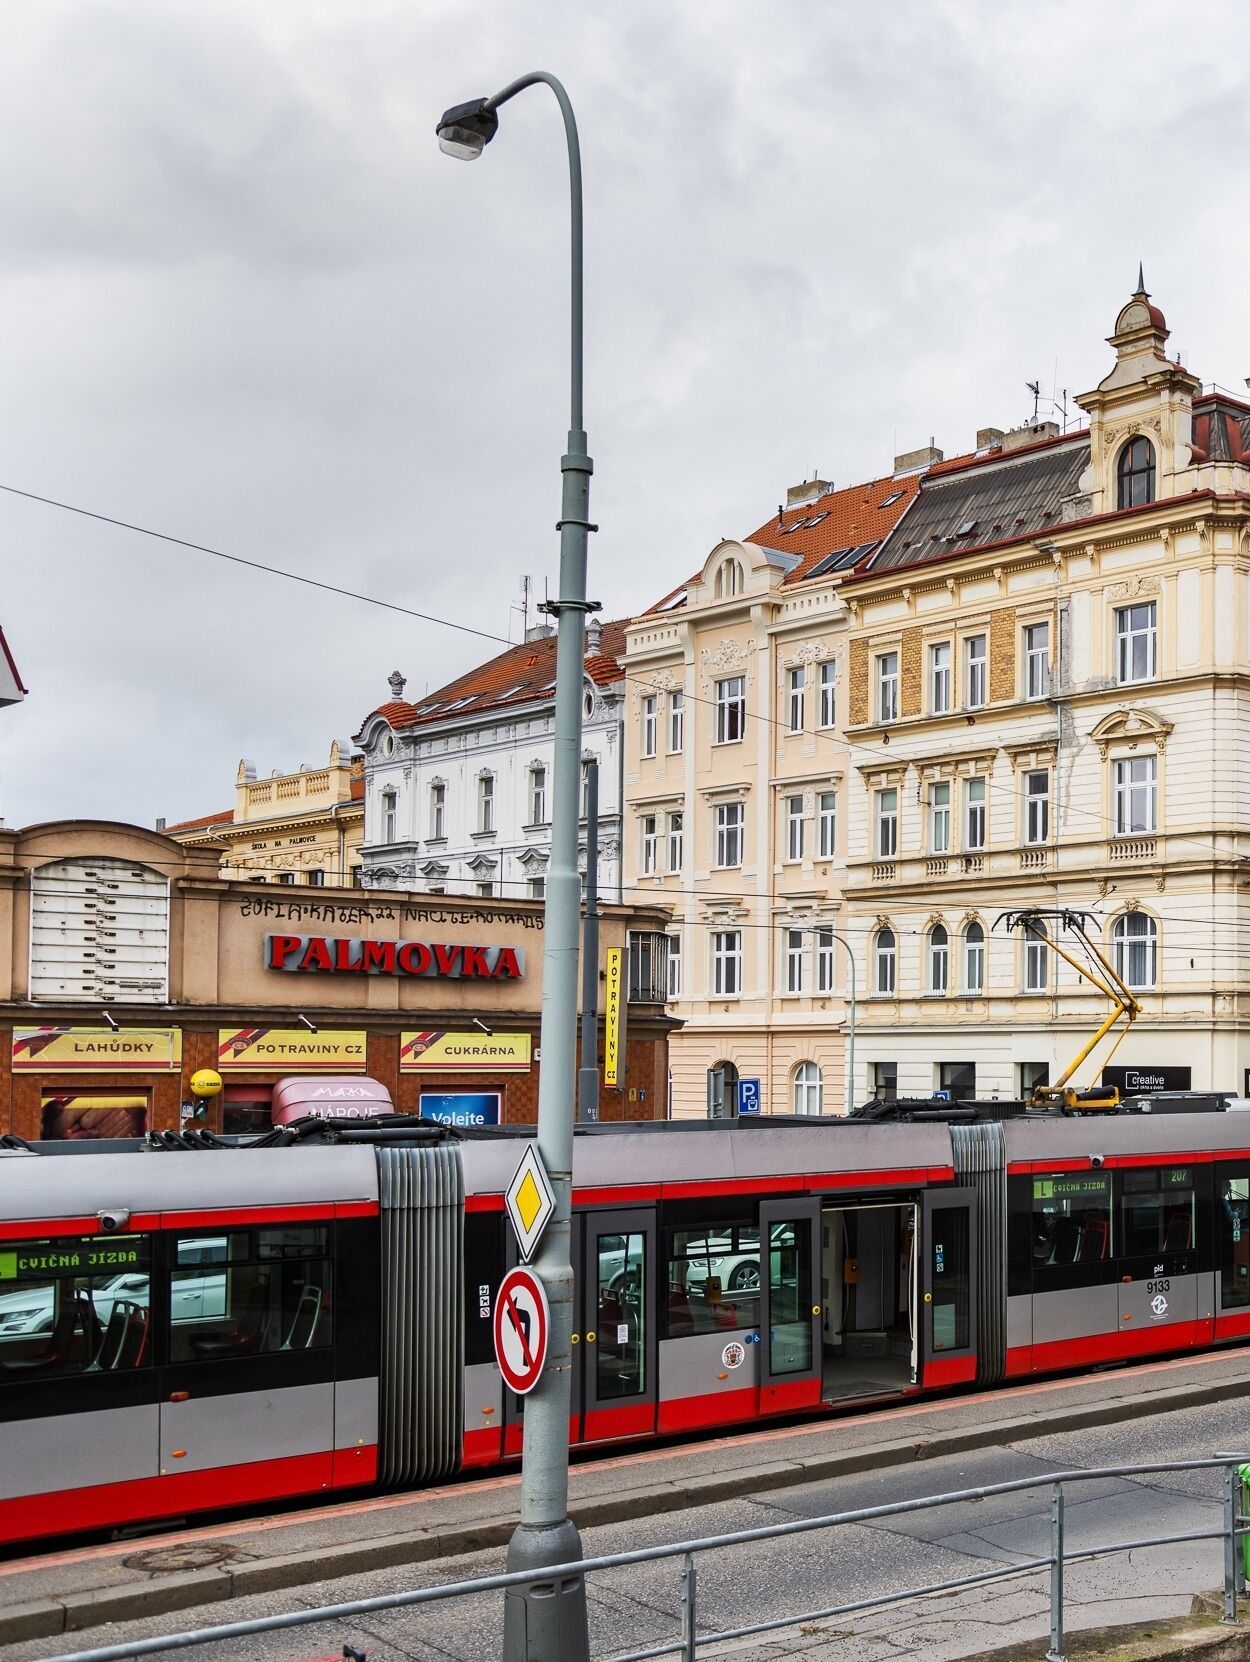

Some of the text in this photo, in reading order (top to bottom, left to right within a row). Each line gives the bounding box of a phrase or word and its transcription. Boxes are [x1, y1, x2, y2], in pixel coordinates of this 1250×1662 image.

[251, 842, 267, 850] ŠKOLA
[289, 834, 317, 845] PALMOVCE
[268, 934, 523, 978] PALMOVKA
[609, 954, 618, 1062] POTRAVINY
[74, 1038, 154, 1053] LAHŮDKY
[345, 1045, 363, 1054] CZ
[444, 1044, 516, 1056] CUKRÁRNA
[606, 1070, 616, 1079] CZ
[1132, 1075, 1165, 1085] creative
[742, 1083, 756, 1103] P
[19, 1250, 137, 1270] CVIČNÁ JÍZDA
[1153, 1264, 1164, 1274] pid
[1146, 1279, 1171, 1295] 9133
